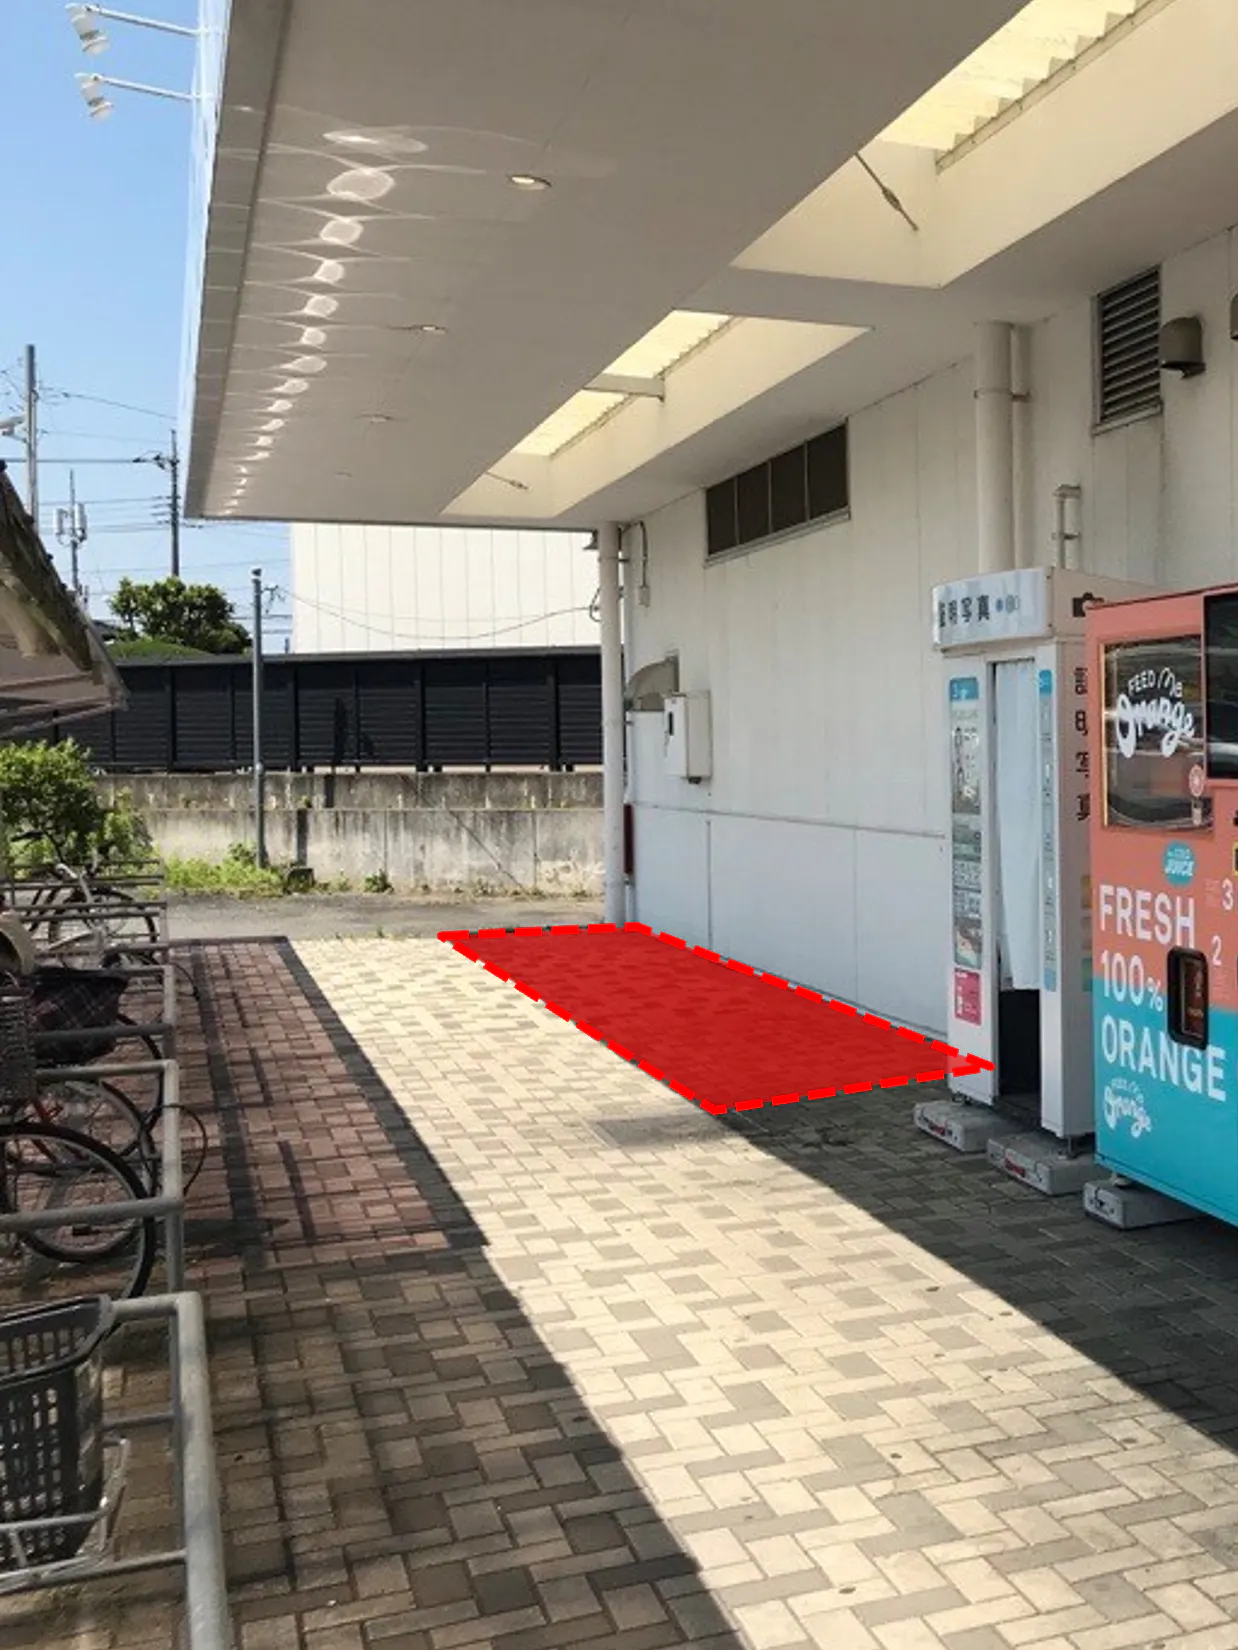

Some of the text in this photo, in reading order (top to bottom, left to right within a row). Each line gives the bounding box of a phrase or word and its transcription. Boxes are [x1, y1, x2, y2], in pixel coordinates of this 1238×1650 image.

[1128, 669, 1157, 698] FEED
[1100, 884, 1196, 950] FRESH
[1222, 878, 1234, 911] 3
[1211, 935, 1222, 966] 2
[1101, 950, 1164, 1012] 100%
[1101, 1015, 1227, 1102] ORANGE
